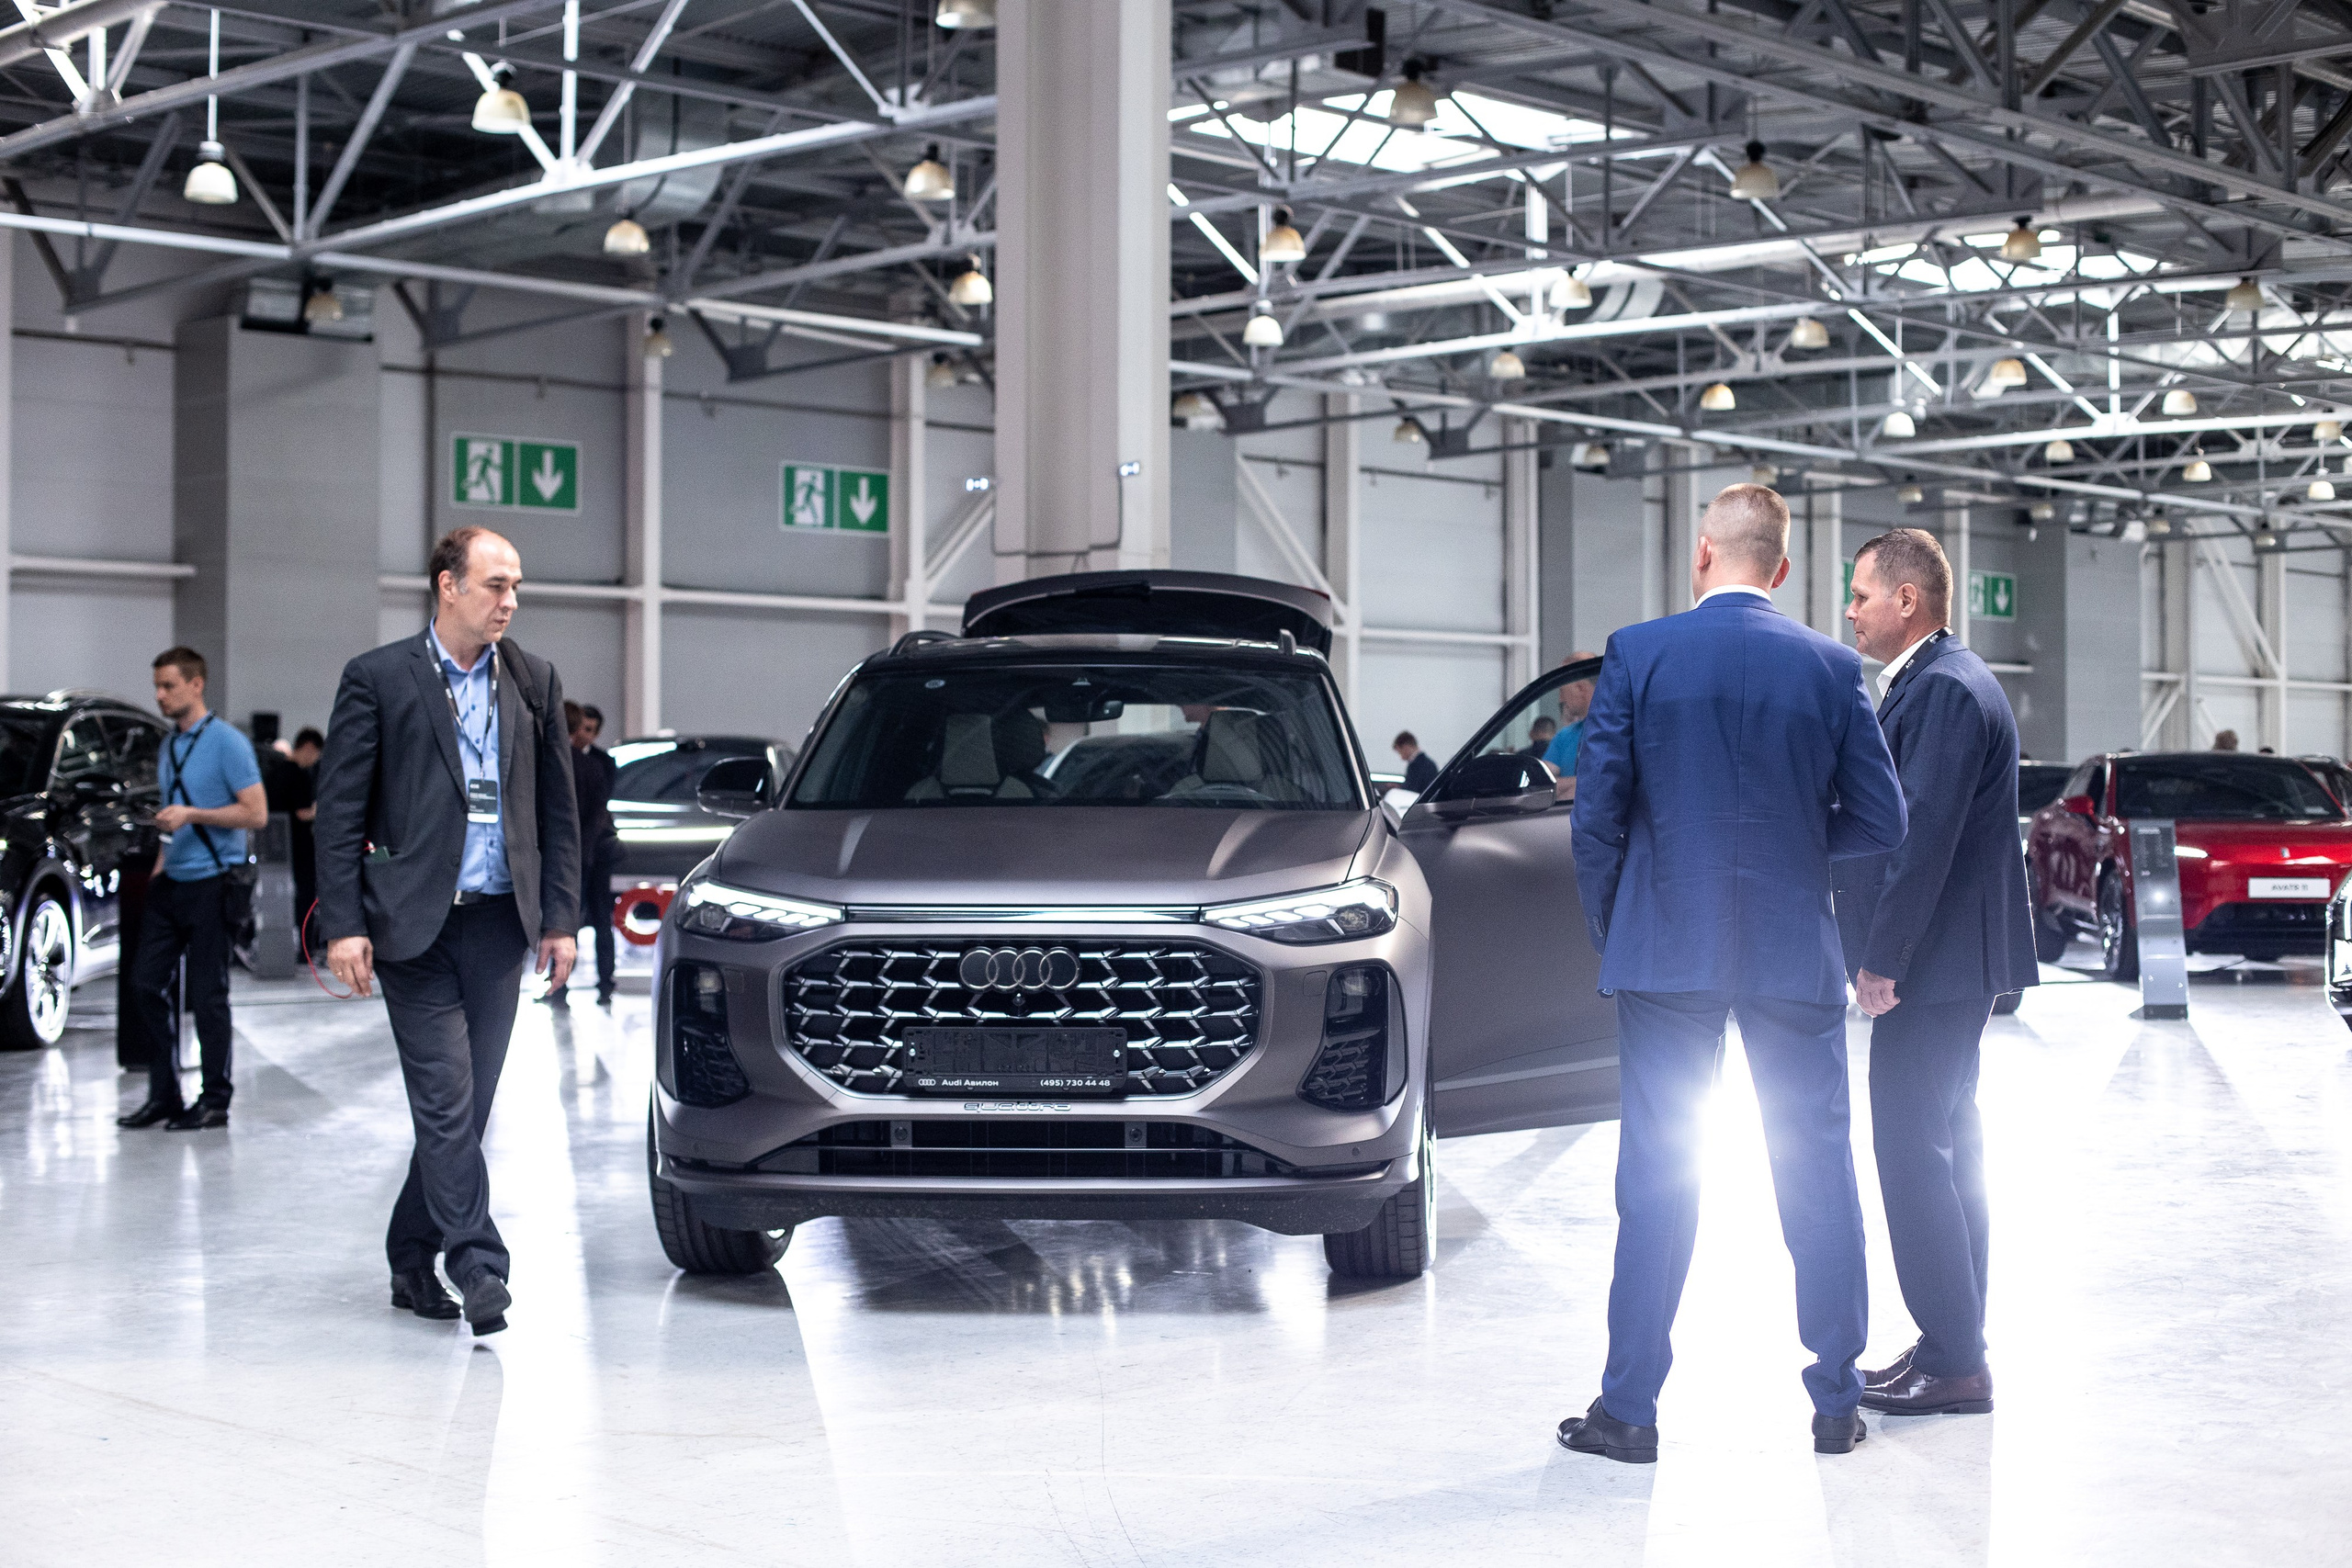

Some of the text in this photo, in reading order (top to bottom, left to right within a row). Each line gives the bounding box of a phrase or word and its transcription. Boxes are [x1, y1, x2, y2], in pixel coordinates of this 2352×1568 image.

[942, 1078, 1000, 1087] Audi Авилон
[1040, 1078, 1064, 1087] (495)
[964, 1101, 1071, 1112] quattro
